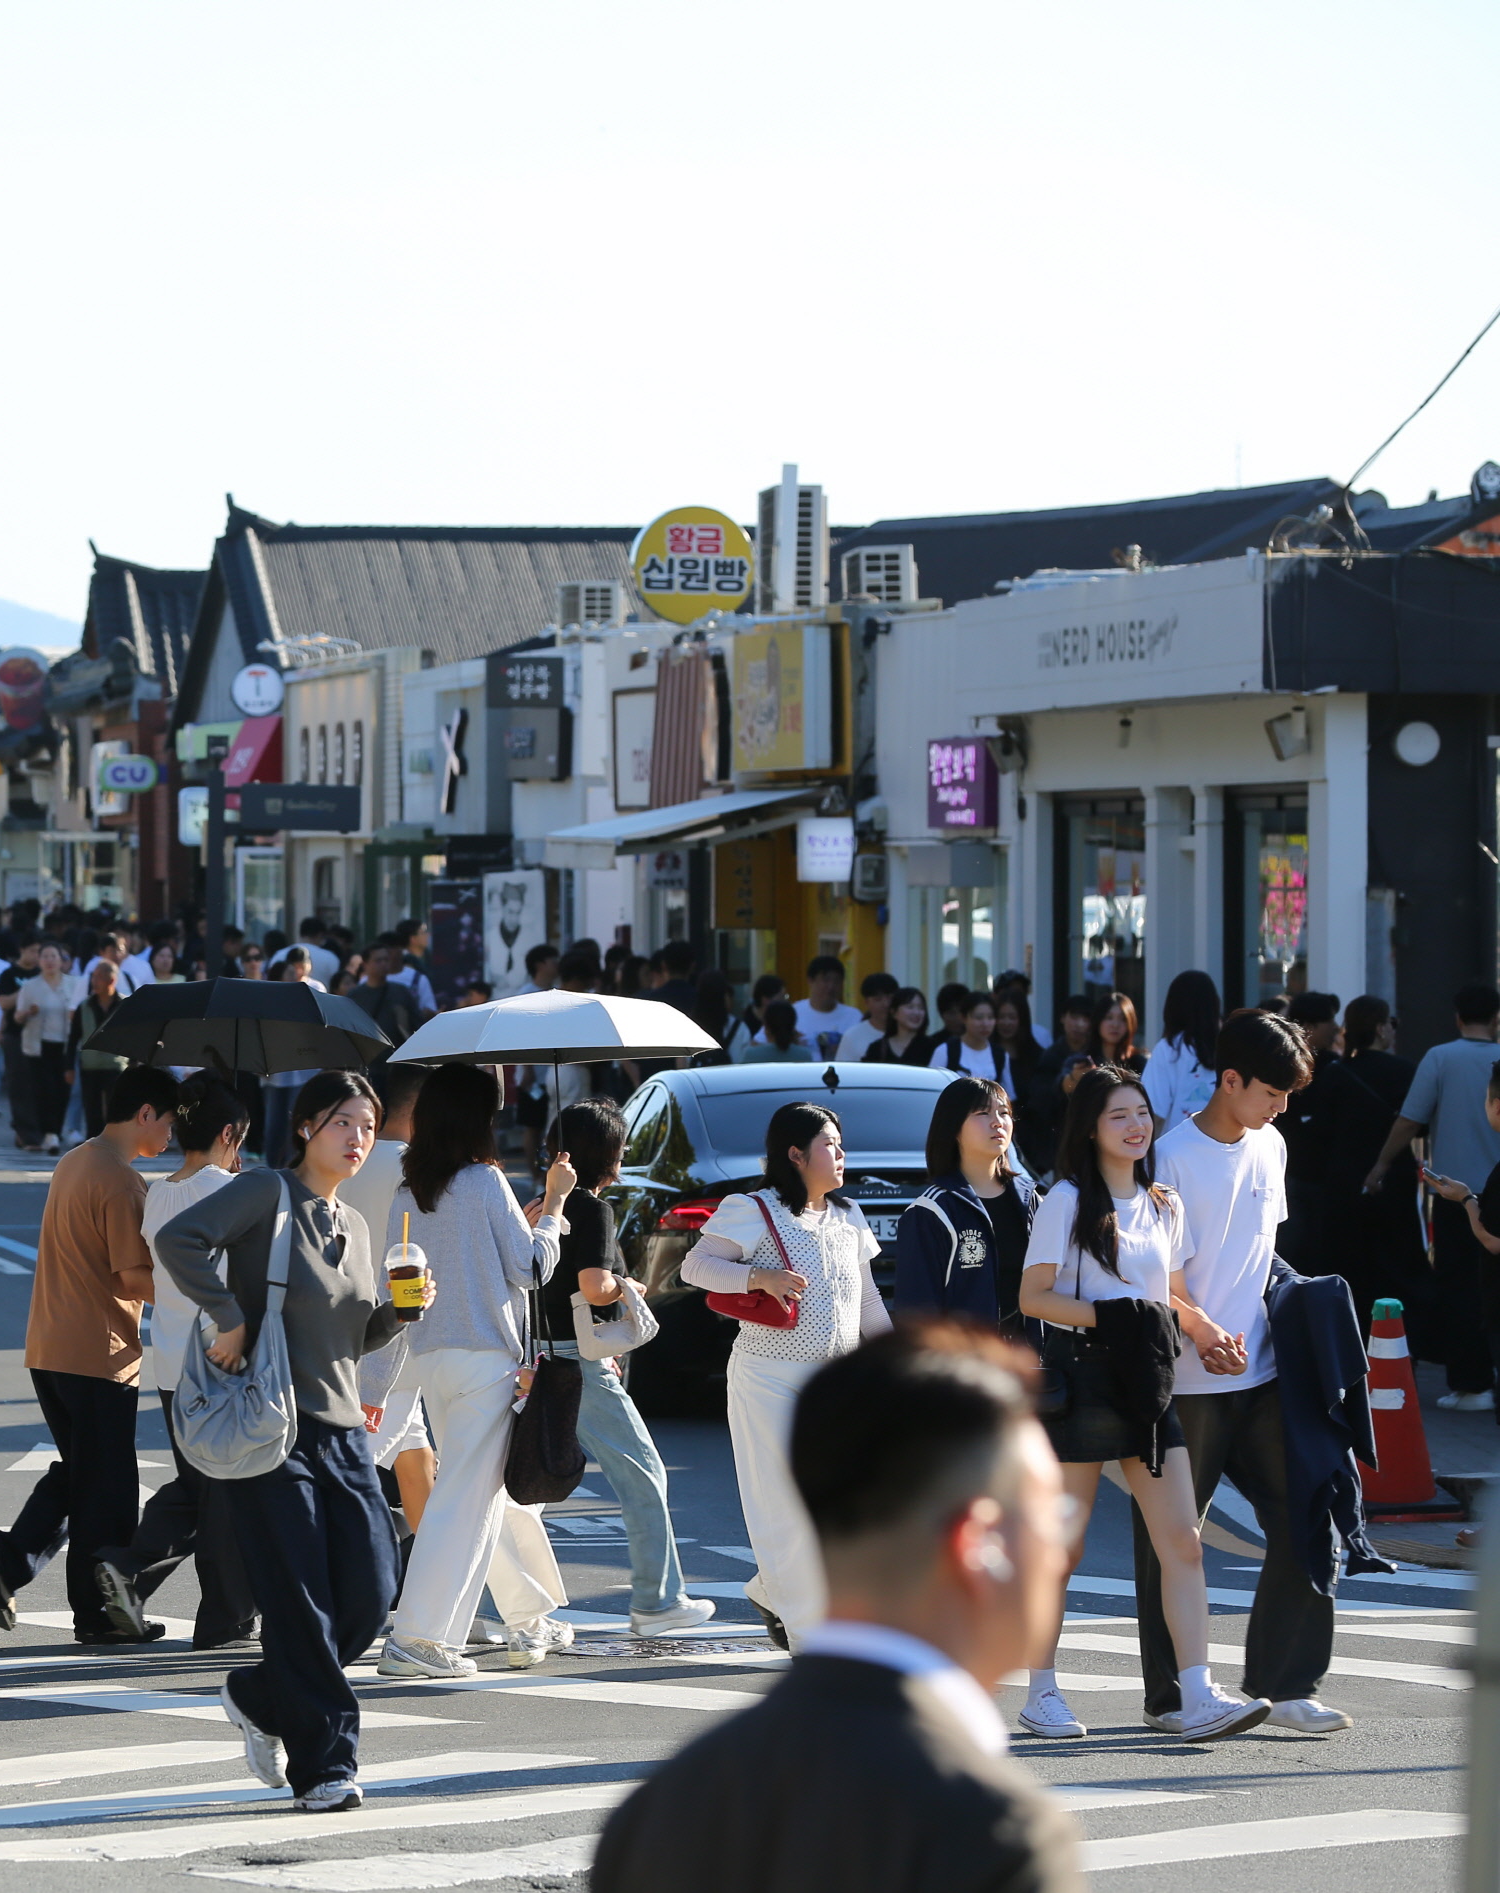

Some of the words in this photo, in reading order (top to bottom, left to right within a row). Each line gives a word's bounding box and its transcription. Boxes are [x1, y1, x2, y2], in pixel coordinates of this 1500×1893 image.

[668, 526, 722, 553] 황금
[643, 557, 749, 592] 십원빵
[1053, 626, 1090, 667] NERD
[1096, 619, 1146, 662] HOUSE
[111, 766, 147, 783] CU
[959, 1229, 982, 1240] ADIDAS
